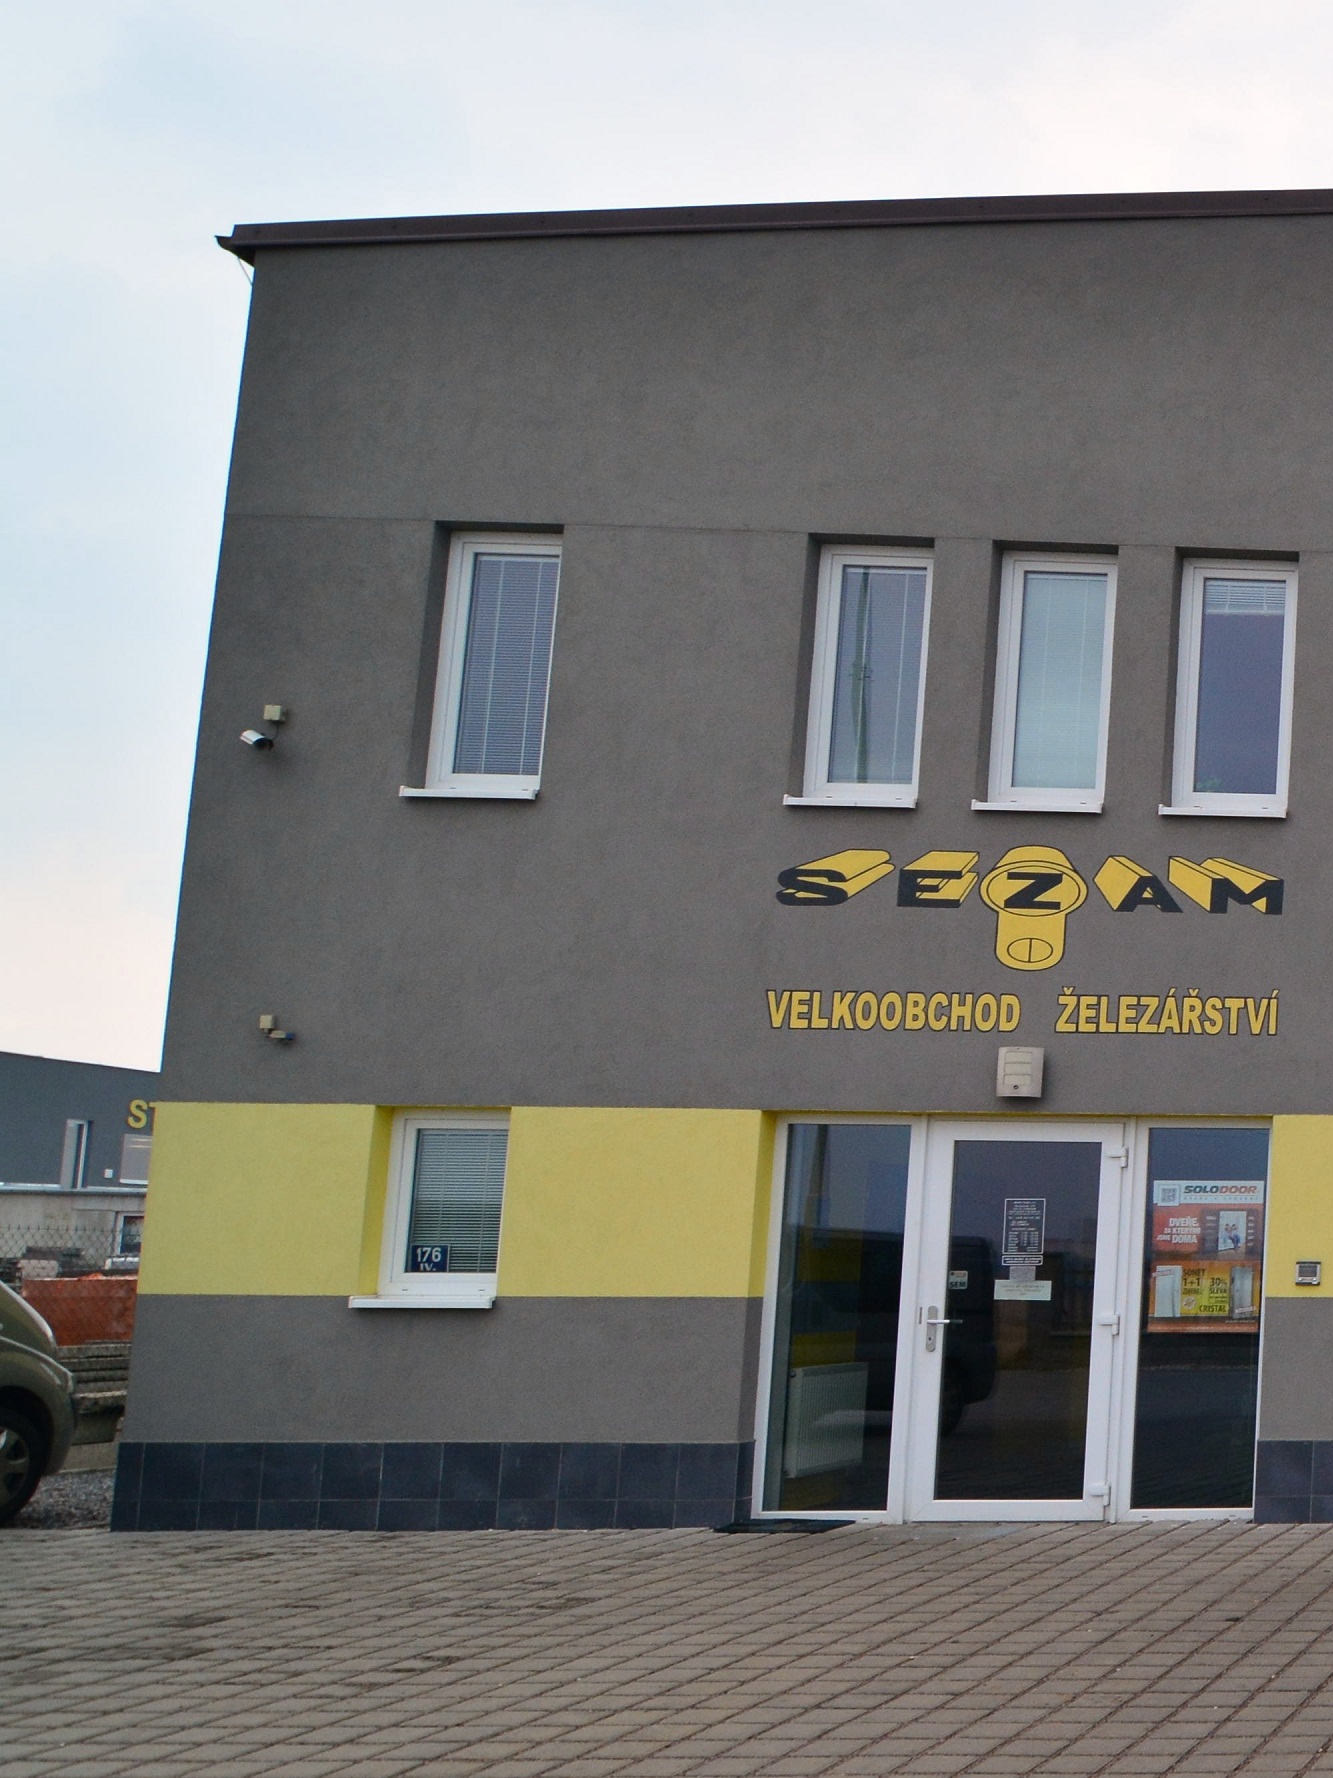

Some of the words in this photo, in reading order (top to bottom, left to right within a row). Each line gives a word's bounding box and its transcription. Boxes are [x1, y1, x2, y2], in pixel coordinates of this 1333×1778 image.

[776, 848, 1284, 916] SEZAM
[767, 989, 1022, 1033] VELKOOBCHOD
[1054, 987, 1281, 1036] ŽELEZÁŘSTVÍ
[127, 1099, 156, 1129] S
[1184, 1185, 1257, 1194] SOLODOOR
[1172, 1234, 1197, 1243] DOMA
[416, 1247, 442, 1263] 176
[1183, 1278, 1200, 1287] 1+1
[1199, 1304, 1227, 1313] CRISTAL
